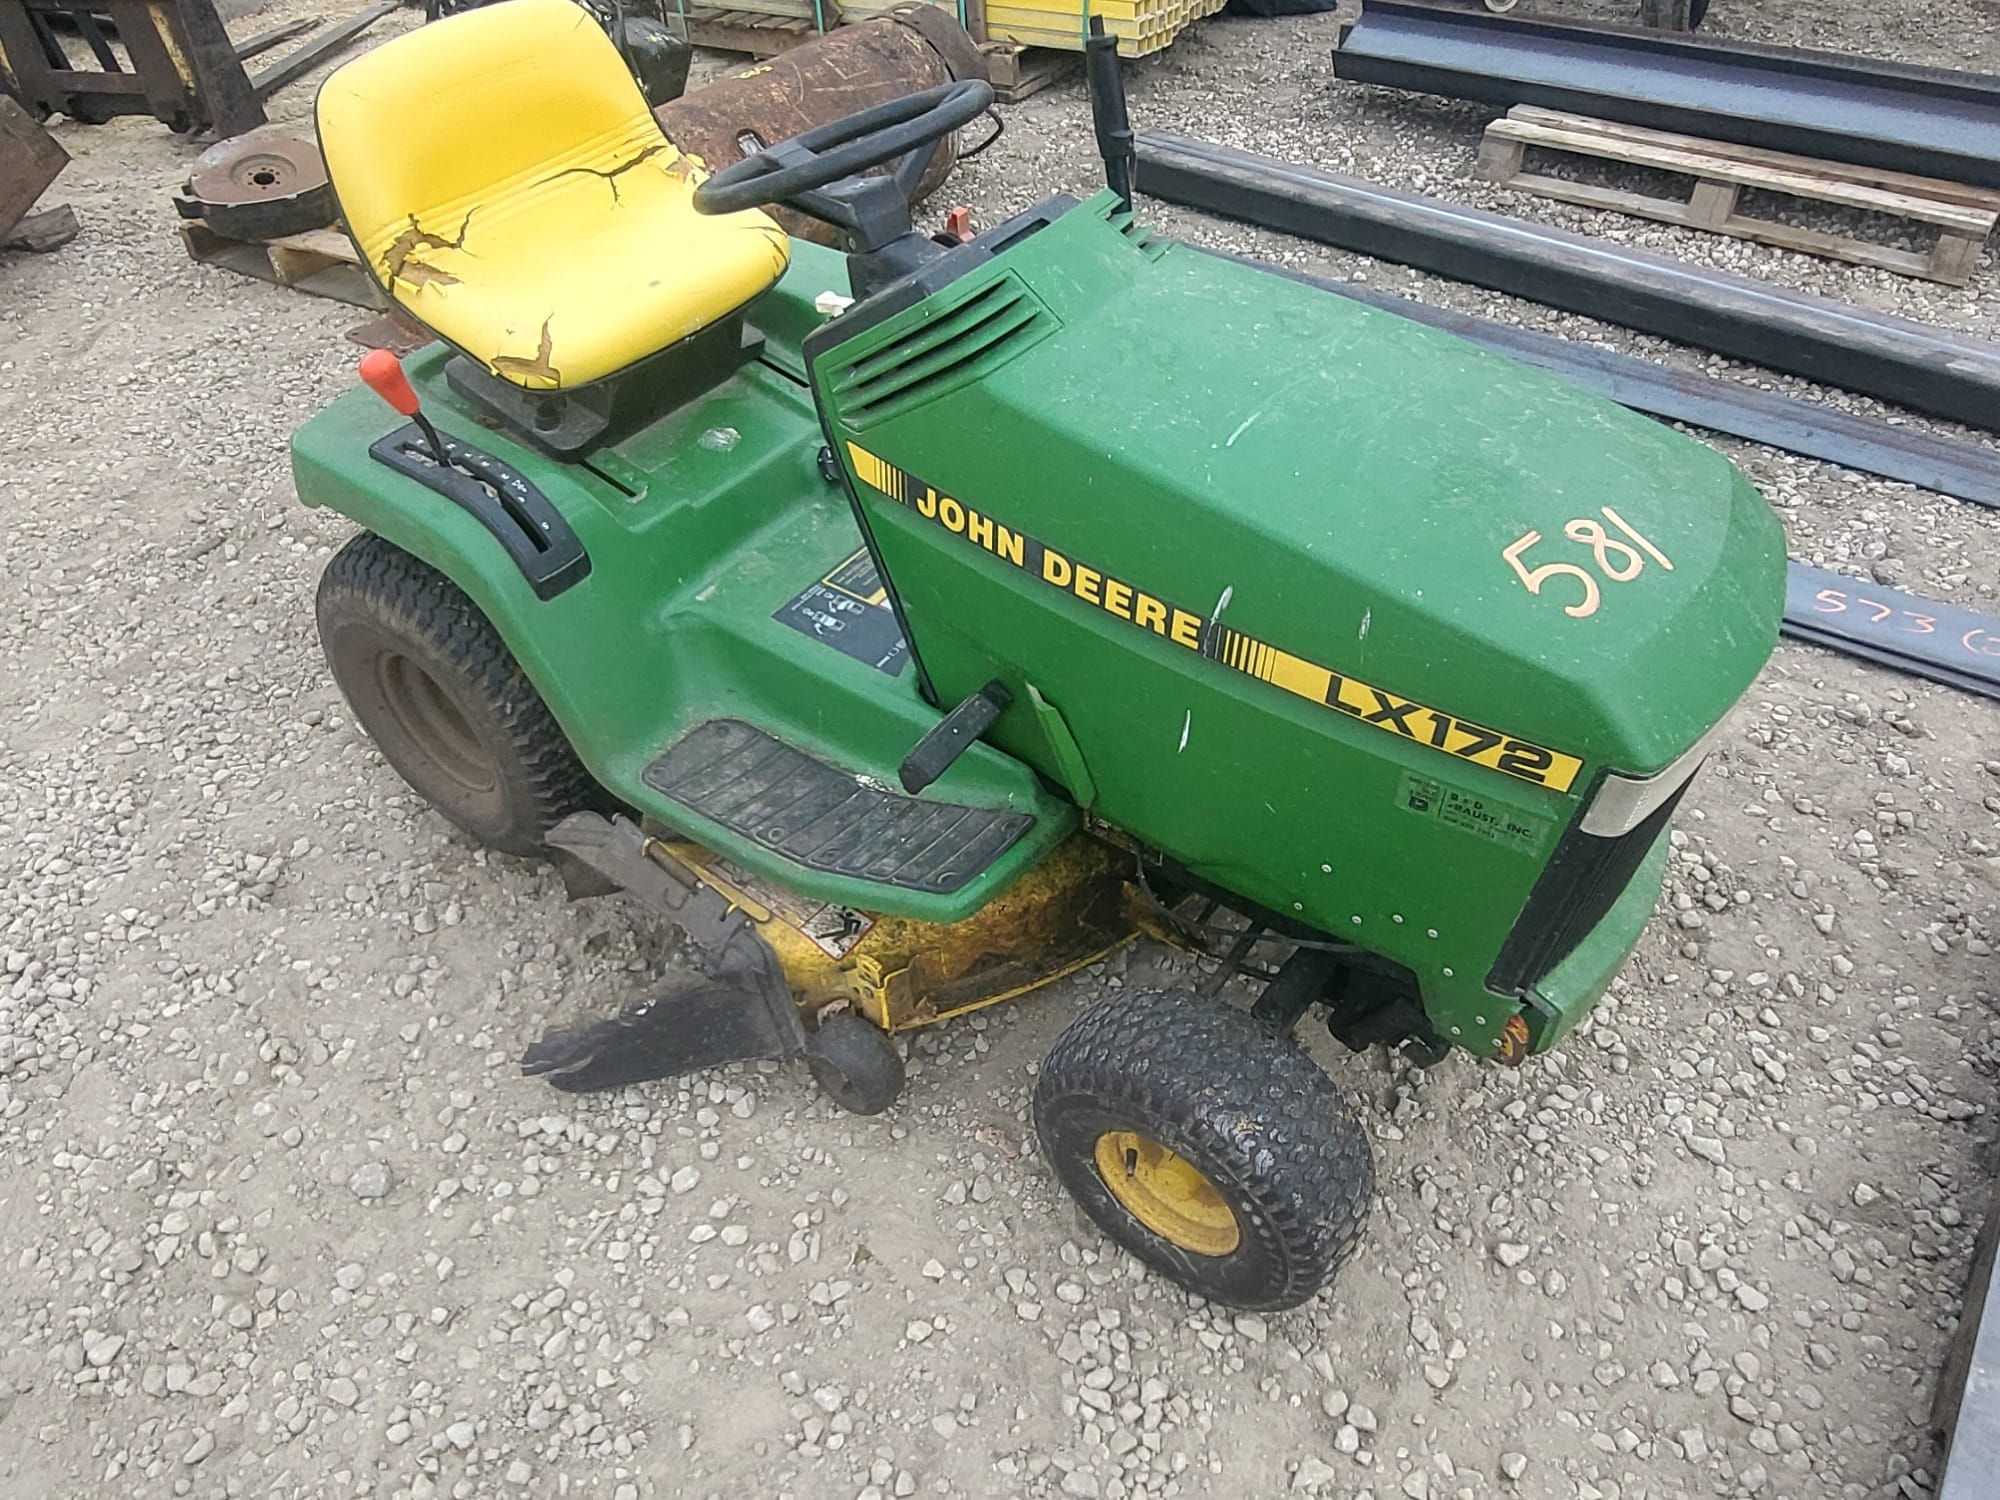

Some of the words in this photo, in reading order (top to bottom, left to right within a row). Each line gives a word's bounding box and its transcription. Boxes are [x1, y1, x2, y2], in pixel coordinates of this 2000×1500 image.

[916, 488, 1025, 567] JOHN
[1042, 548, 1202, 651] DEERE
[1502, 506, 1674, 618] 581
[1813, 590, 1936, 634] 573
[1324, 674, 1554, 783] LX172
